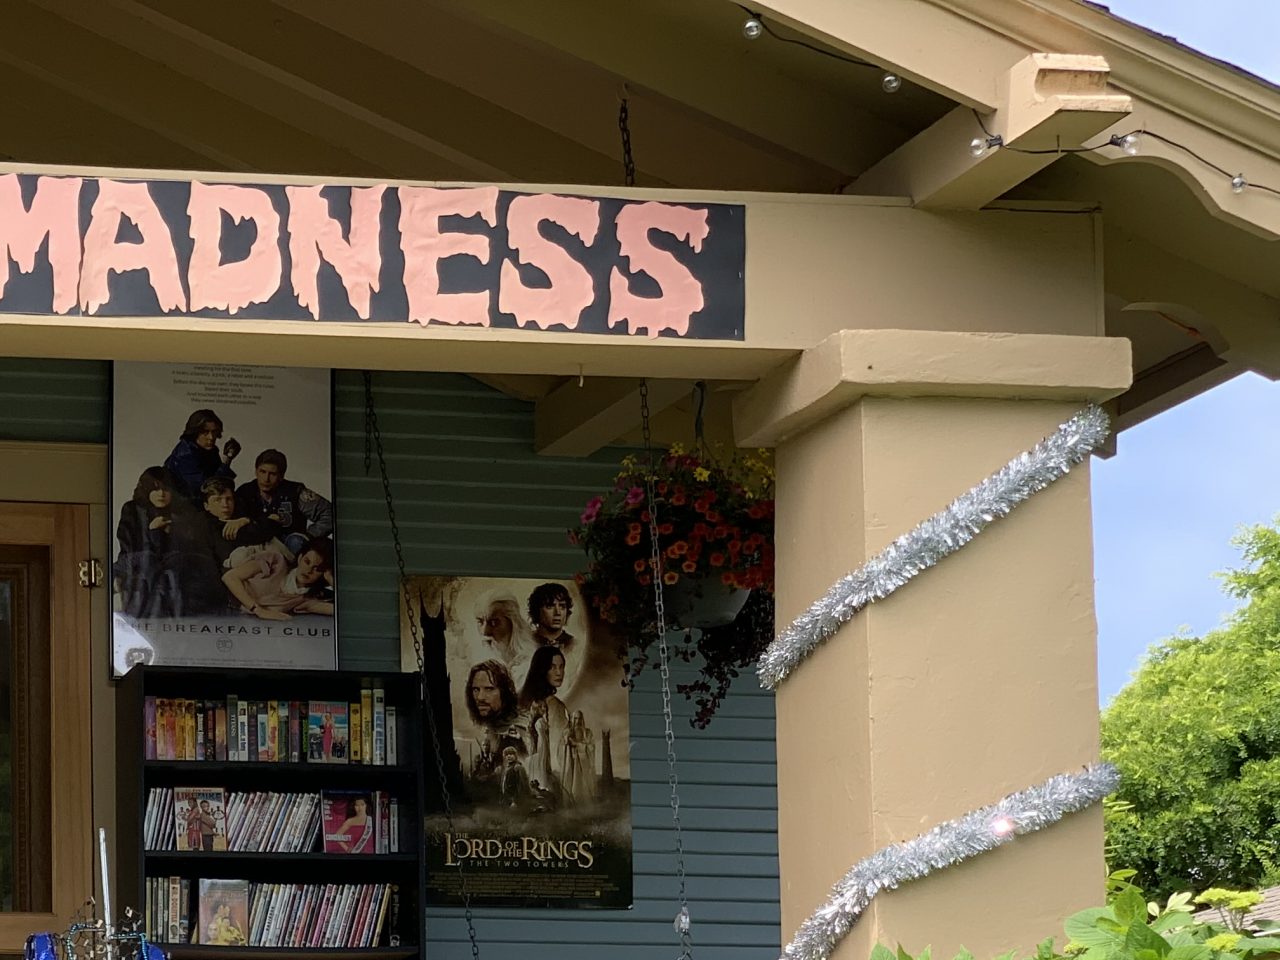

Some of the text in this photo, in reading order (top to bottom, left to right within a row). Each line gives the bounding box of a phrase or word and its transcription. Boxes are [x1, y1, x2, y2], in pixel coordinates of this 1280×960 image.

[283, 627, 331, 637] CLUB
[444, 833, 594, 868] LORD OF THE RINGS
